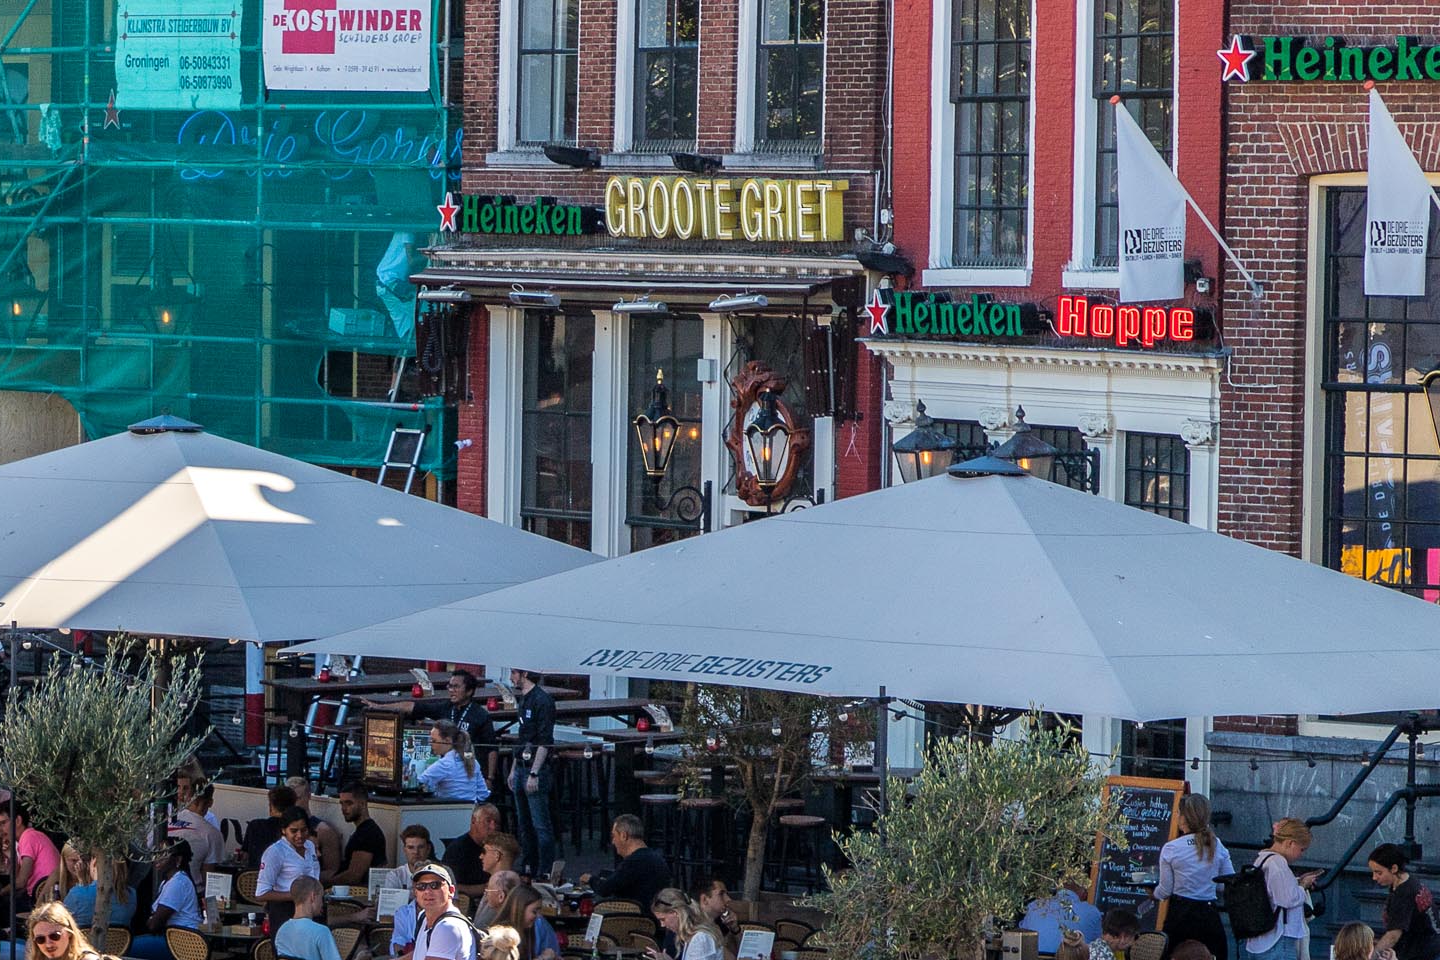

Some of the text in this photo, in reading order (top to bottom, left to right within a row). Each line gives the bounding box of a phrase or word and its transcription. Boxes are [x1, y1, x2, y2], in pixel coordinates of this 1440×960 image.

[127, 18, 232, 33] KLIJNSTRA STEIGERBOUW BV
[125, 54, 231, 71] Groningen 06-50843331
[180, 75, 232, 90] 06-50873990
[462, 174, 844, 242] Heineken GROOTE GRIET
[1142, 239, 1182, 254] GEZUSTERS
[1387, 234, 1424, 247] GEZUSTERS
[894, 291, 1195, 348] Heineken Hoppe
[612, 650, 833, 684] DE DRIE GEZUSTERS
